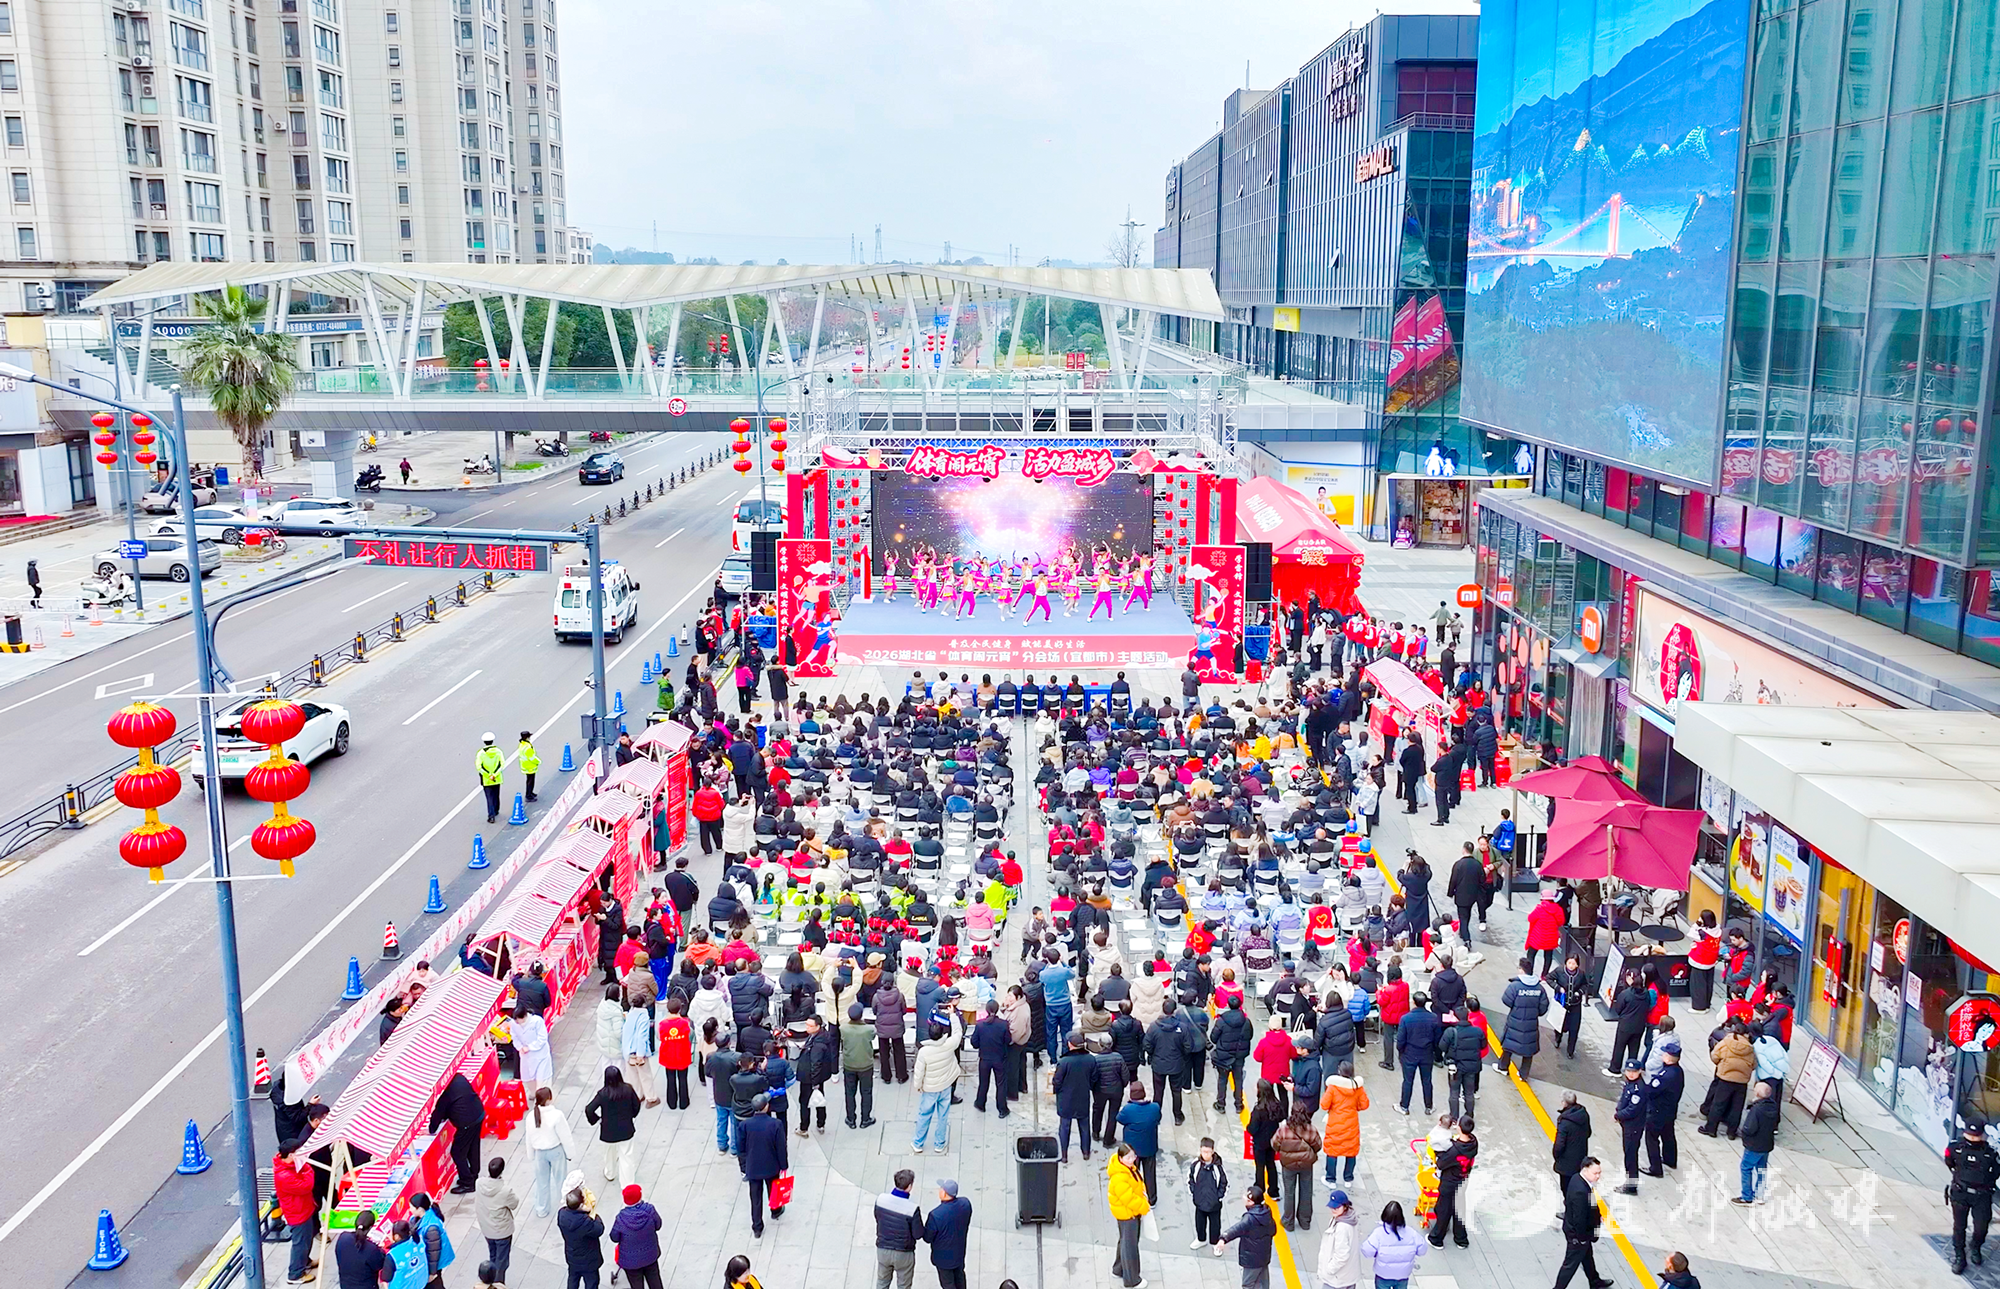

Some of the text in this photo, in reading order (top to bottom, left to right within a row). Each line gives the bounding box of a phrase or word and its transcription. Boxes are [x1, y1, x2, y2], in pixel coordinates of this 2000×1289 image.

[908, 447, 1005, 477] 体育闹元宵
[1022, 448, 1115, 485] 活力盈城乡
[355, 540, 536, 570] 不礼让行人抓拍
[948, 639, 1085, 649] 普及全民健身 赋能美好生活
